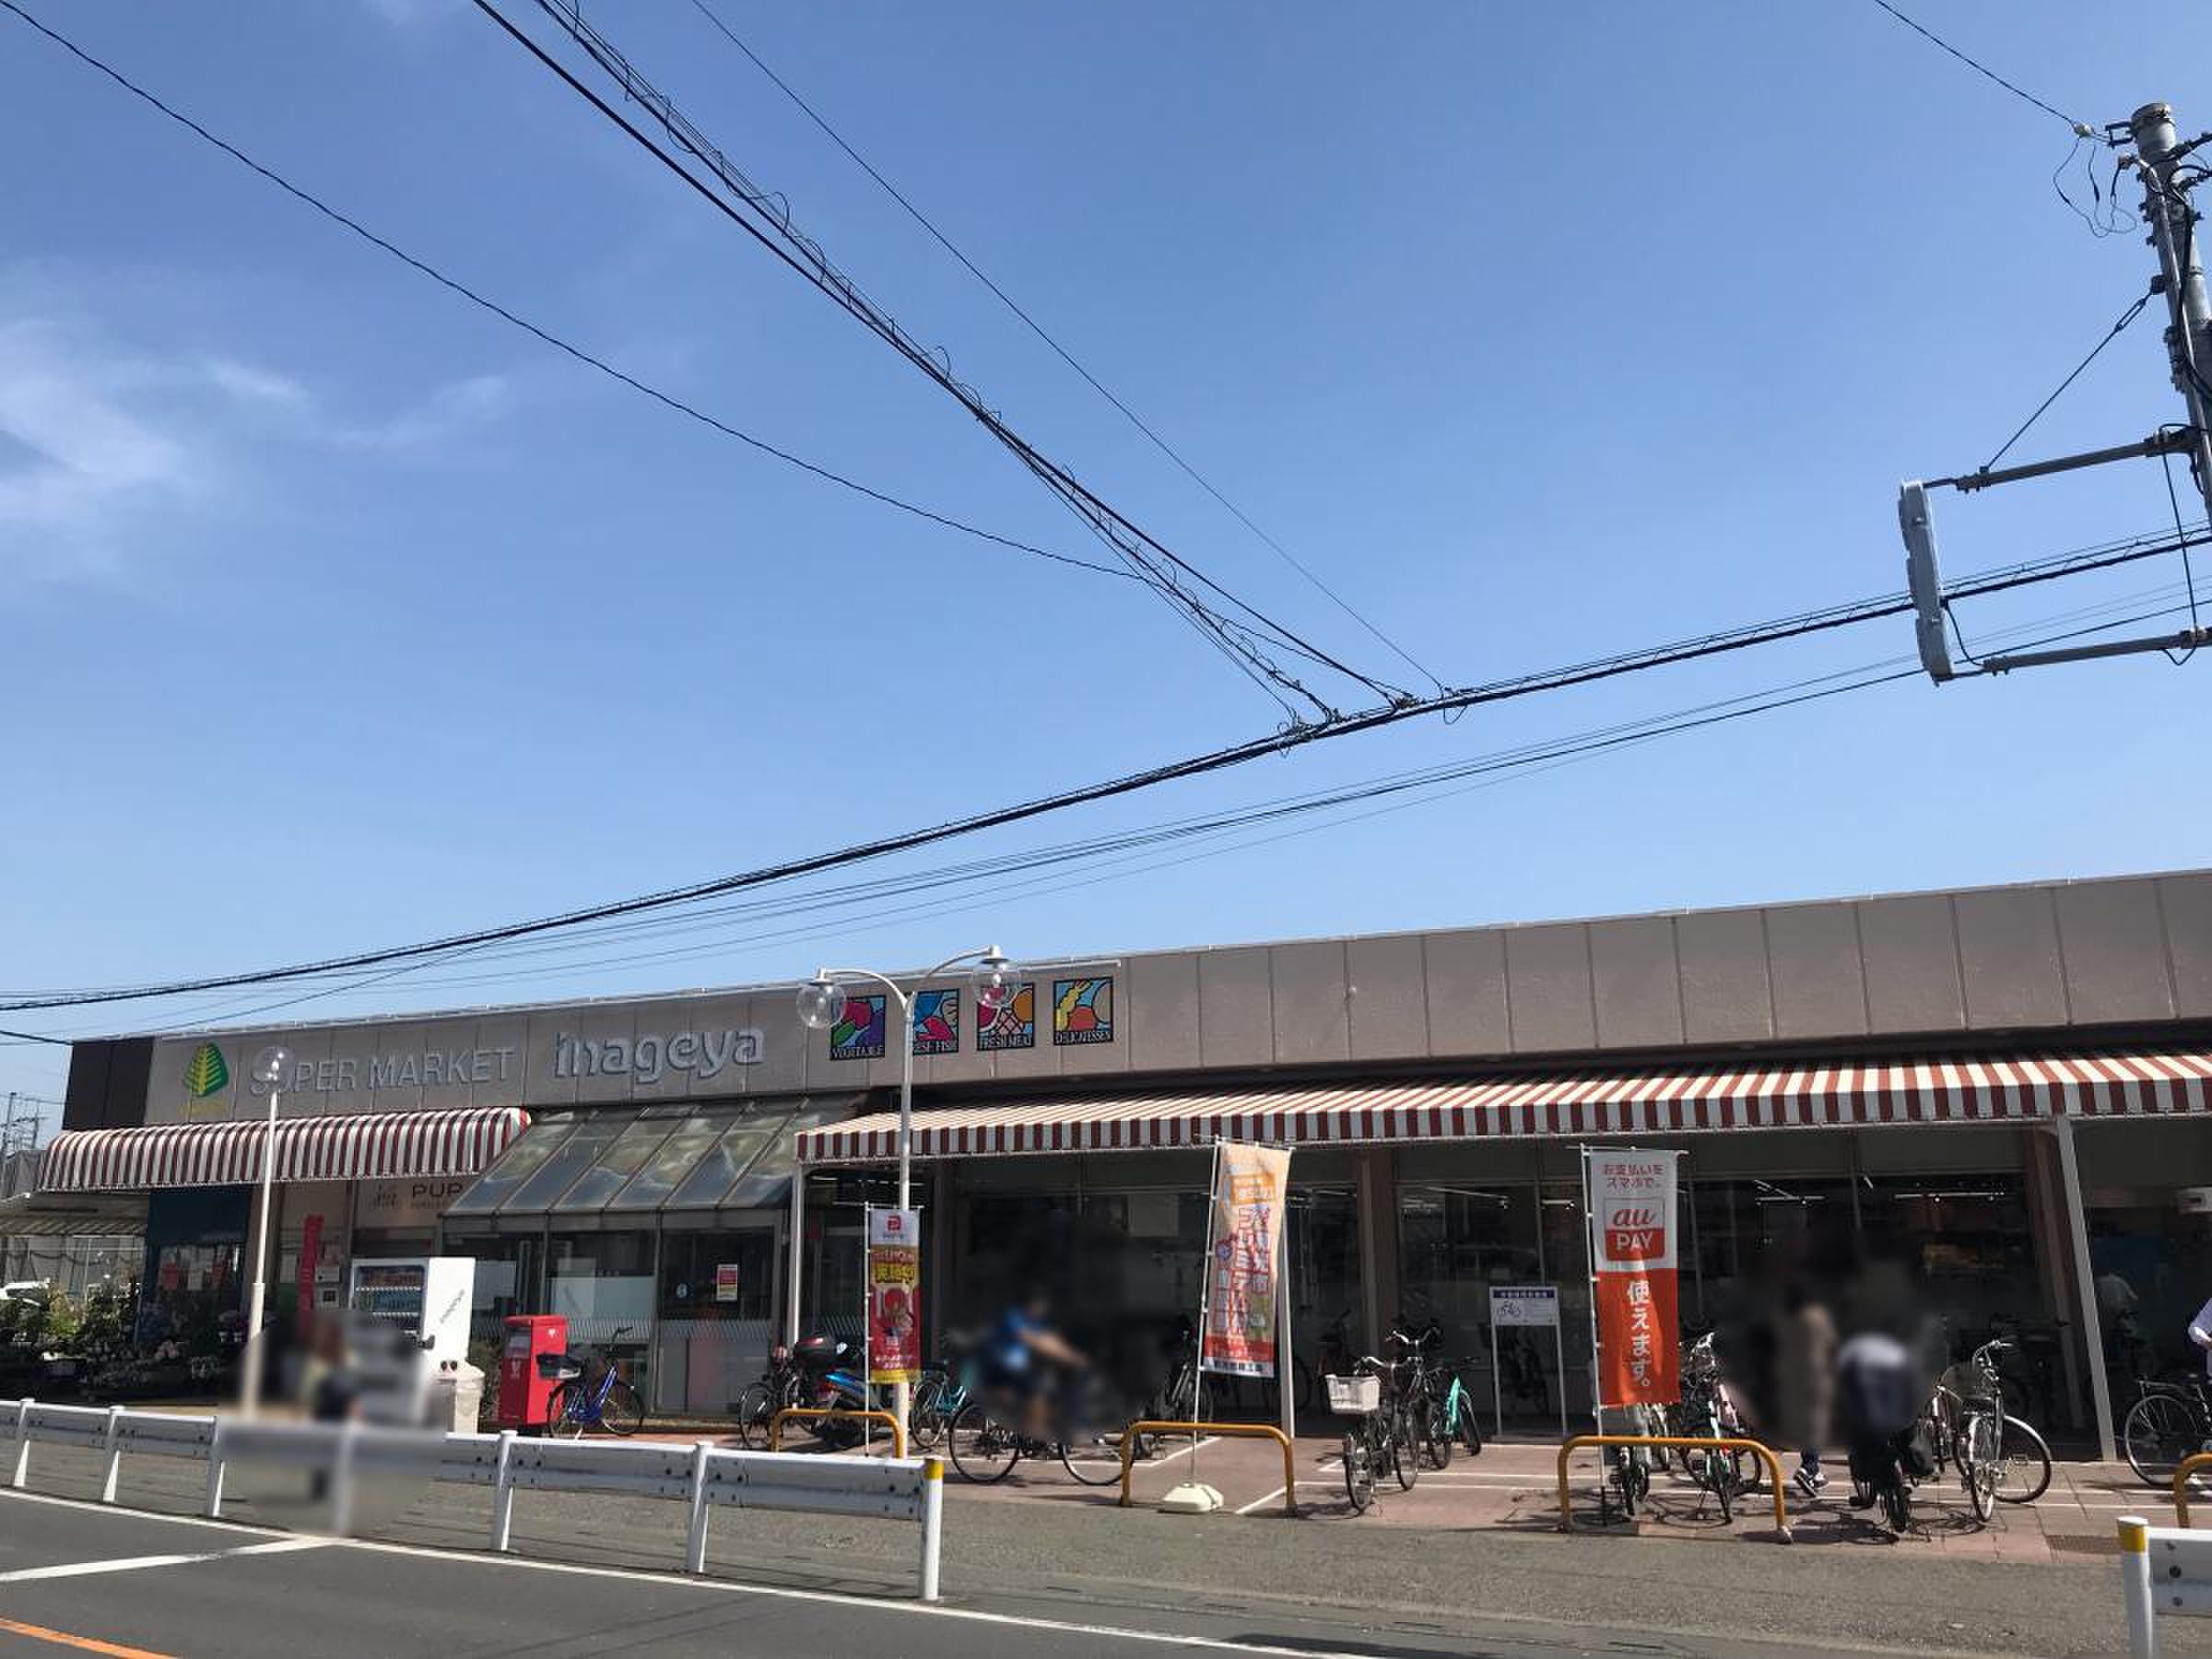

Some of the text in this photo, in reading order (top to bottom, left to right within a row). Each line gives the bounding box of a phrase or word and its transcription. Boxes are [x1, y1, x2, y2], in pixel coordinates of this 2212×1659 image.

[369, 1047, 516, 1091] MARKET
[555, 1027, 766, 1085] inageya
[1612, 1208, 1657, 1226] au
[1616, 1230, 1653, 1252] PAY
[1627, 1278, 1652, 1388] 使えます。
